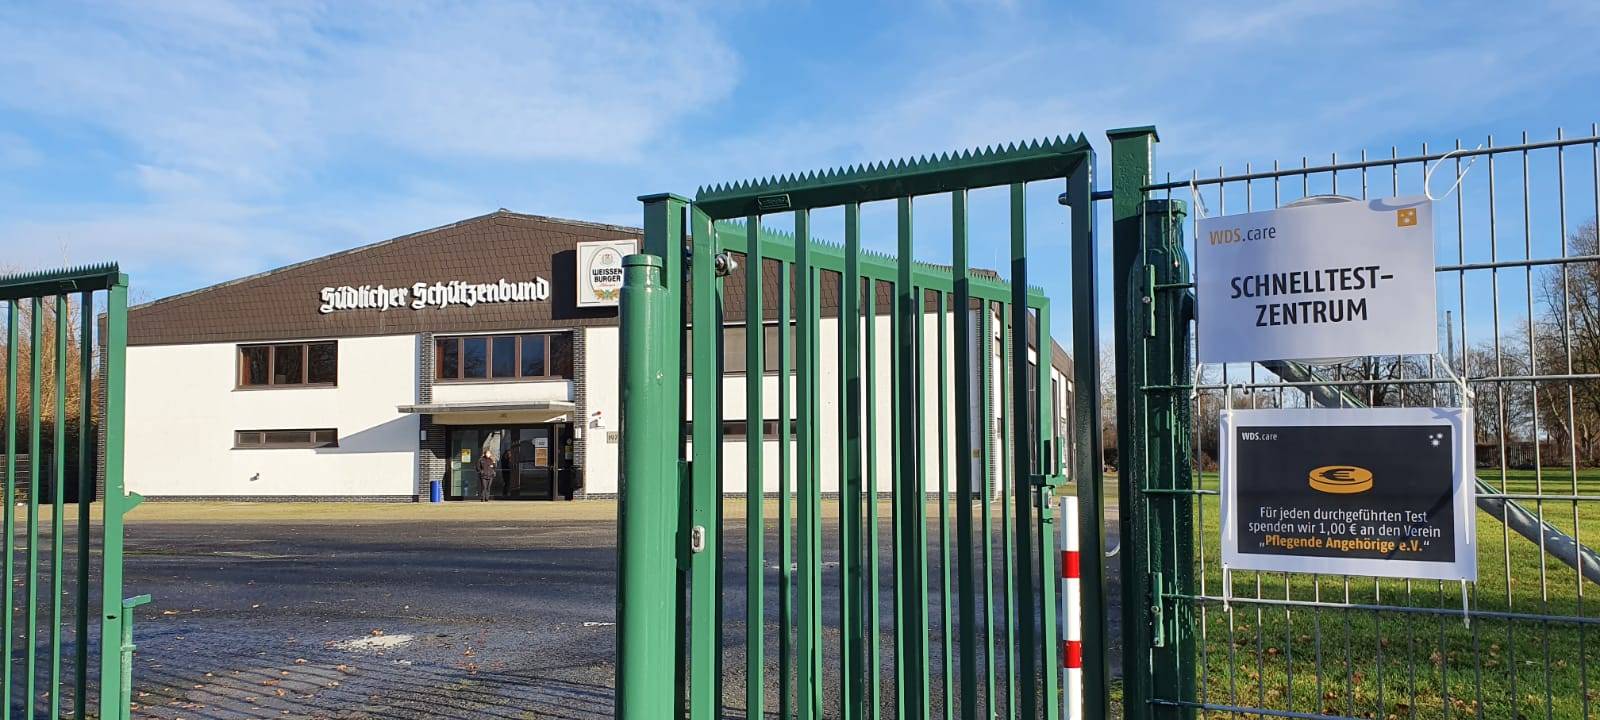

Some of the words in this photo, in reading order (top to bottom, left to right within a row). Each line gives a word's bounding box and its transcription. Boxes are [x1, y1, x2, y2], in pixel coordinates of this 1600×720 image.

[1209, 224, 1277, 246] WDS.care
[594, 275, 621, 283] BURGER
[1230, 265, 1394, 299] SCHNELLTEST-
[320, 284, 408, 314] Südlicher
[411, 276, 550, 310] Schützenbund
[1255, 298, 1368, 327] ZENTRUM
[1241, 431, 1278, 441] WDS.care
[1260, 506, 1277, 518] Für
[1279, 507, 1310, 520] jeden
[1313, 507, 1402, 523] durchgeführten
[1404, 510, 1428, 523] Test
[1248, 521, 1294, 533] spenden
[1297, 521, 1316, 534] wir
[1319, 522, 1345, 535] 1,00
[1349, 523, 1357, 535] €
[1360, 525, 1375, 536] an
[1378, 524, 1401, 536] den
[1403, 525, 1441, 538] Verein
[1326, 537, 1395, 553] Angehörige
